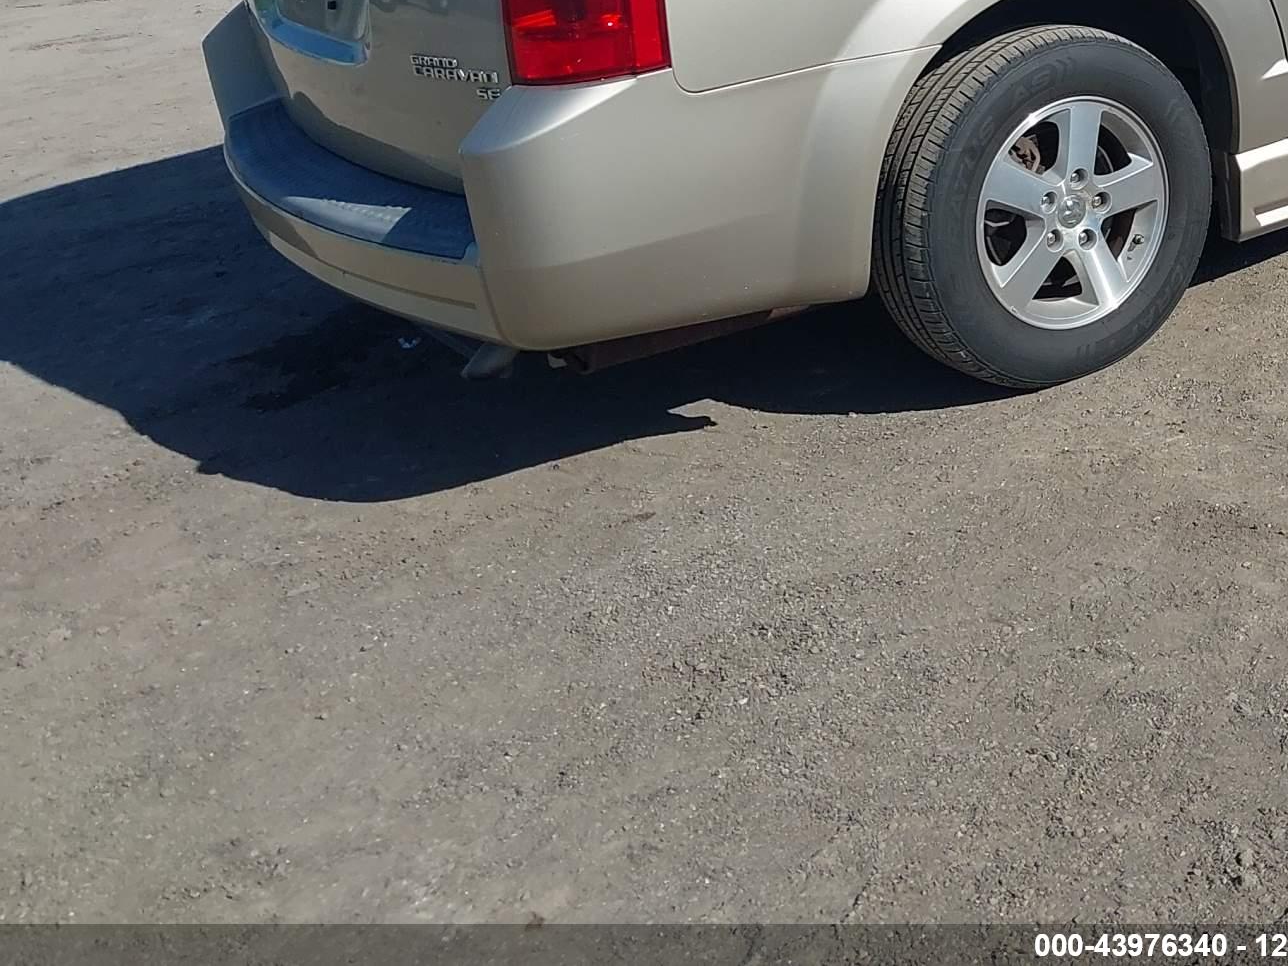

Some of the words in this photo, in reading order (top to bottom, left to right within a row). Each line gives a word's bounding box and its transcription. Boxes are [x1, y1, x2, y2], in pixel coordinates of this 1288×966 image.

[410, 54, 457, 68] GRAND
[412, 65, 499, 83] CARAVAN
[476, 88, 501, 100] SE
